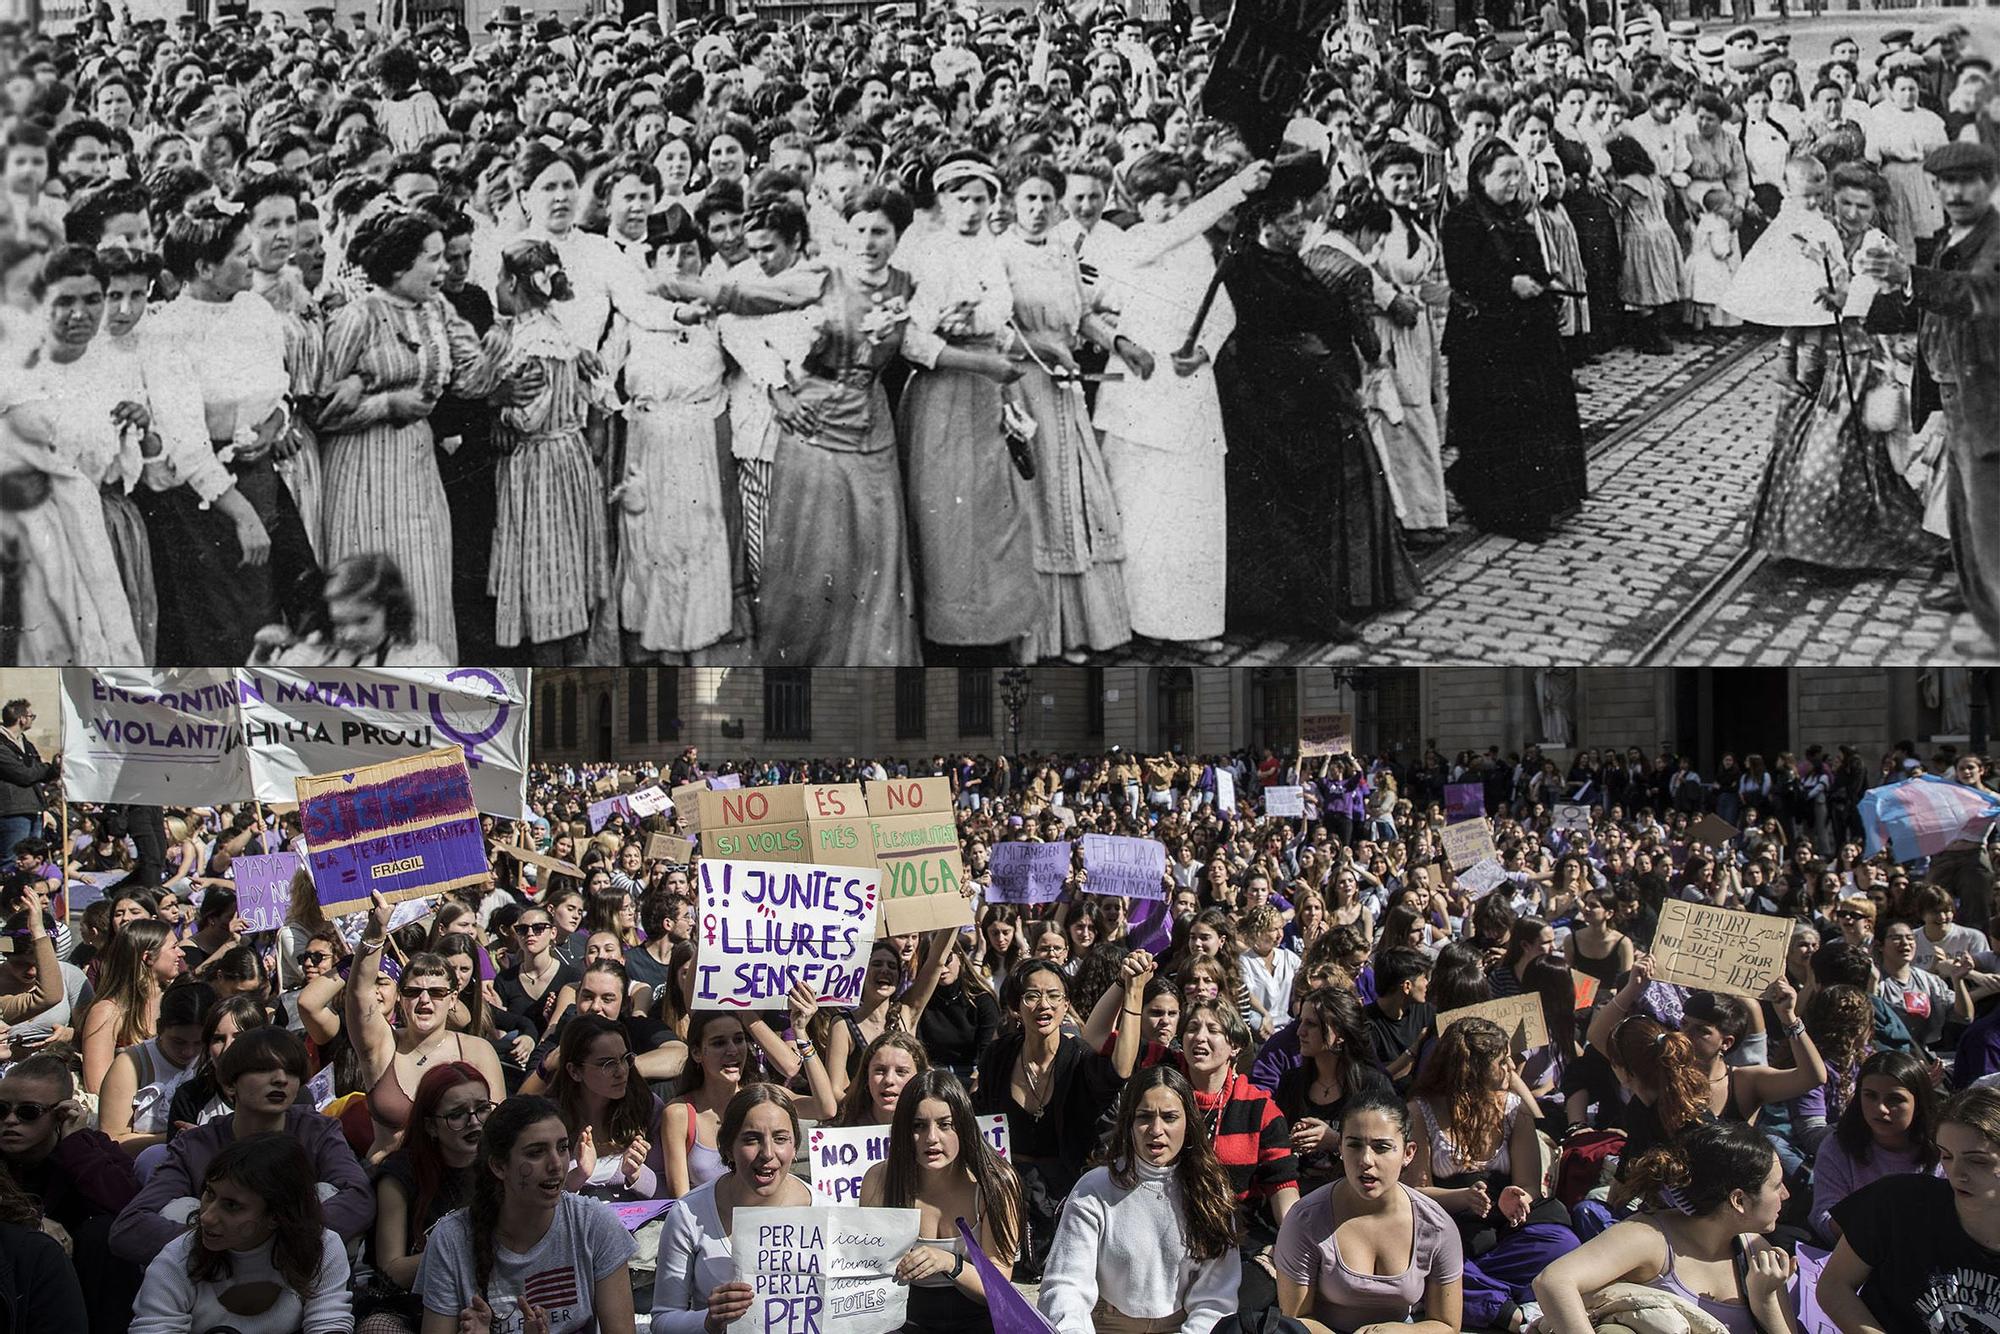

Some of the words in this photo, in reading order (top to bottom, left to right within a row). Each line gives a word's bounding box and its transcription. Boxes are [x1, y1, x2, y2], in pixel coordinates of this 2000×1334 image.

[277, 680, 400, 709] MATANT
[409, 684, 419, 710] I
[246, 721, 279, 747] HI
[284, 720, 336, 744] HA
[722, 791, 769, 826] NO
[814, 787, 846, 817] ÉS
[887, 782, 923, 811] NO
[717, 831, 741, 856] SI
[746, 828, 804, 854] VOLS
[820, 824, 860, 850] MÉS
[233, 856, 286, 879] MAMA
[885, 858, 960, 898] YOGA
[238, 884, 267, 905] HOY
[241, 905, 284, 935] SOLA
[1667, 905, 1751, 935] SUPPORT
[1755, 928, 1787, 942] YOUR
[721, 917, 860, 961] LLIURES
[1687, 928, 1761, 953] SISTERS
[1686, 942, 1727, 960] JUST
[1736, 952, 1774, 968] YOUR
[697, 965, 721, 999] I
[822, 964, 866, 999] POR
[822, 1143, 859, 1168] NO
[759, 1224, 795, 1248] PER
[800, 1225, 824, 1250] LA
[832, 1232, 887, 1248] iaia
[757, 1249, 793, 1273] PER
[797, 1252, 820, 1274] LA
[756, 1273, 792, 1295] PER
[795, 1275, 819, 1295] LA
[764, 1295, 824, 1334] PER
[830, 1287, 887, 1314] TOTES
